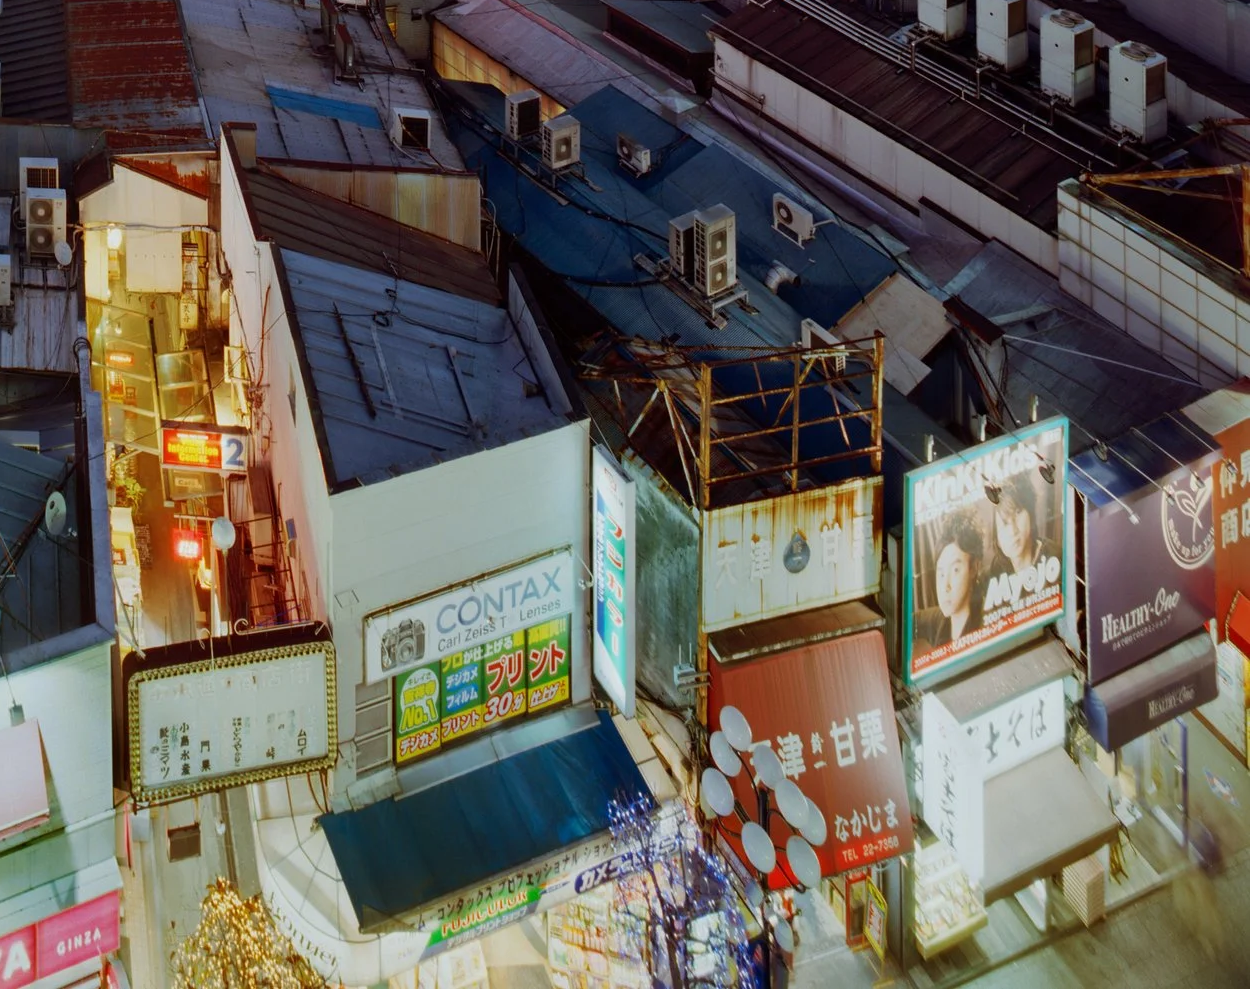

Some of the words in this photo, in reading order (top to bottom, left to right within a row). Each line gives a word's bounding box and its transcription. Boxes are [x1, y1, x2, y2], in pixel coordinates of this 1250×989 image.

[225, 438, 244, 467] 2
[436, 566, 562, 635] CONTAX
[437, 634, 461, 653] Carl
[465, 624, 496, 644] Zeiss
[519, 599, 561, 622] Lenses
[446, 667, 479, 689] デジカメ
[486, 640, 565, 694] プリント
[400, 698, 439, 734] No.1
[446, 686, 479, 709] フィルム
[400, 727, 439, 757] デジカメ
[442, 711, 480, 737] プリント
[483, 692, 526, 723] 30分
[829, 708, 888, 768] 甘栗
[834, 798, 899, 843] なかじま
[842, 849, 859, 864] TEL
[441, 890, 528, 938] FUJICOLOR
[56, 926, 102, 957] GINZA
